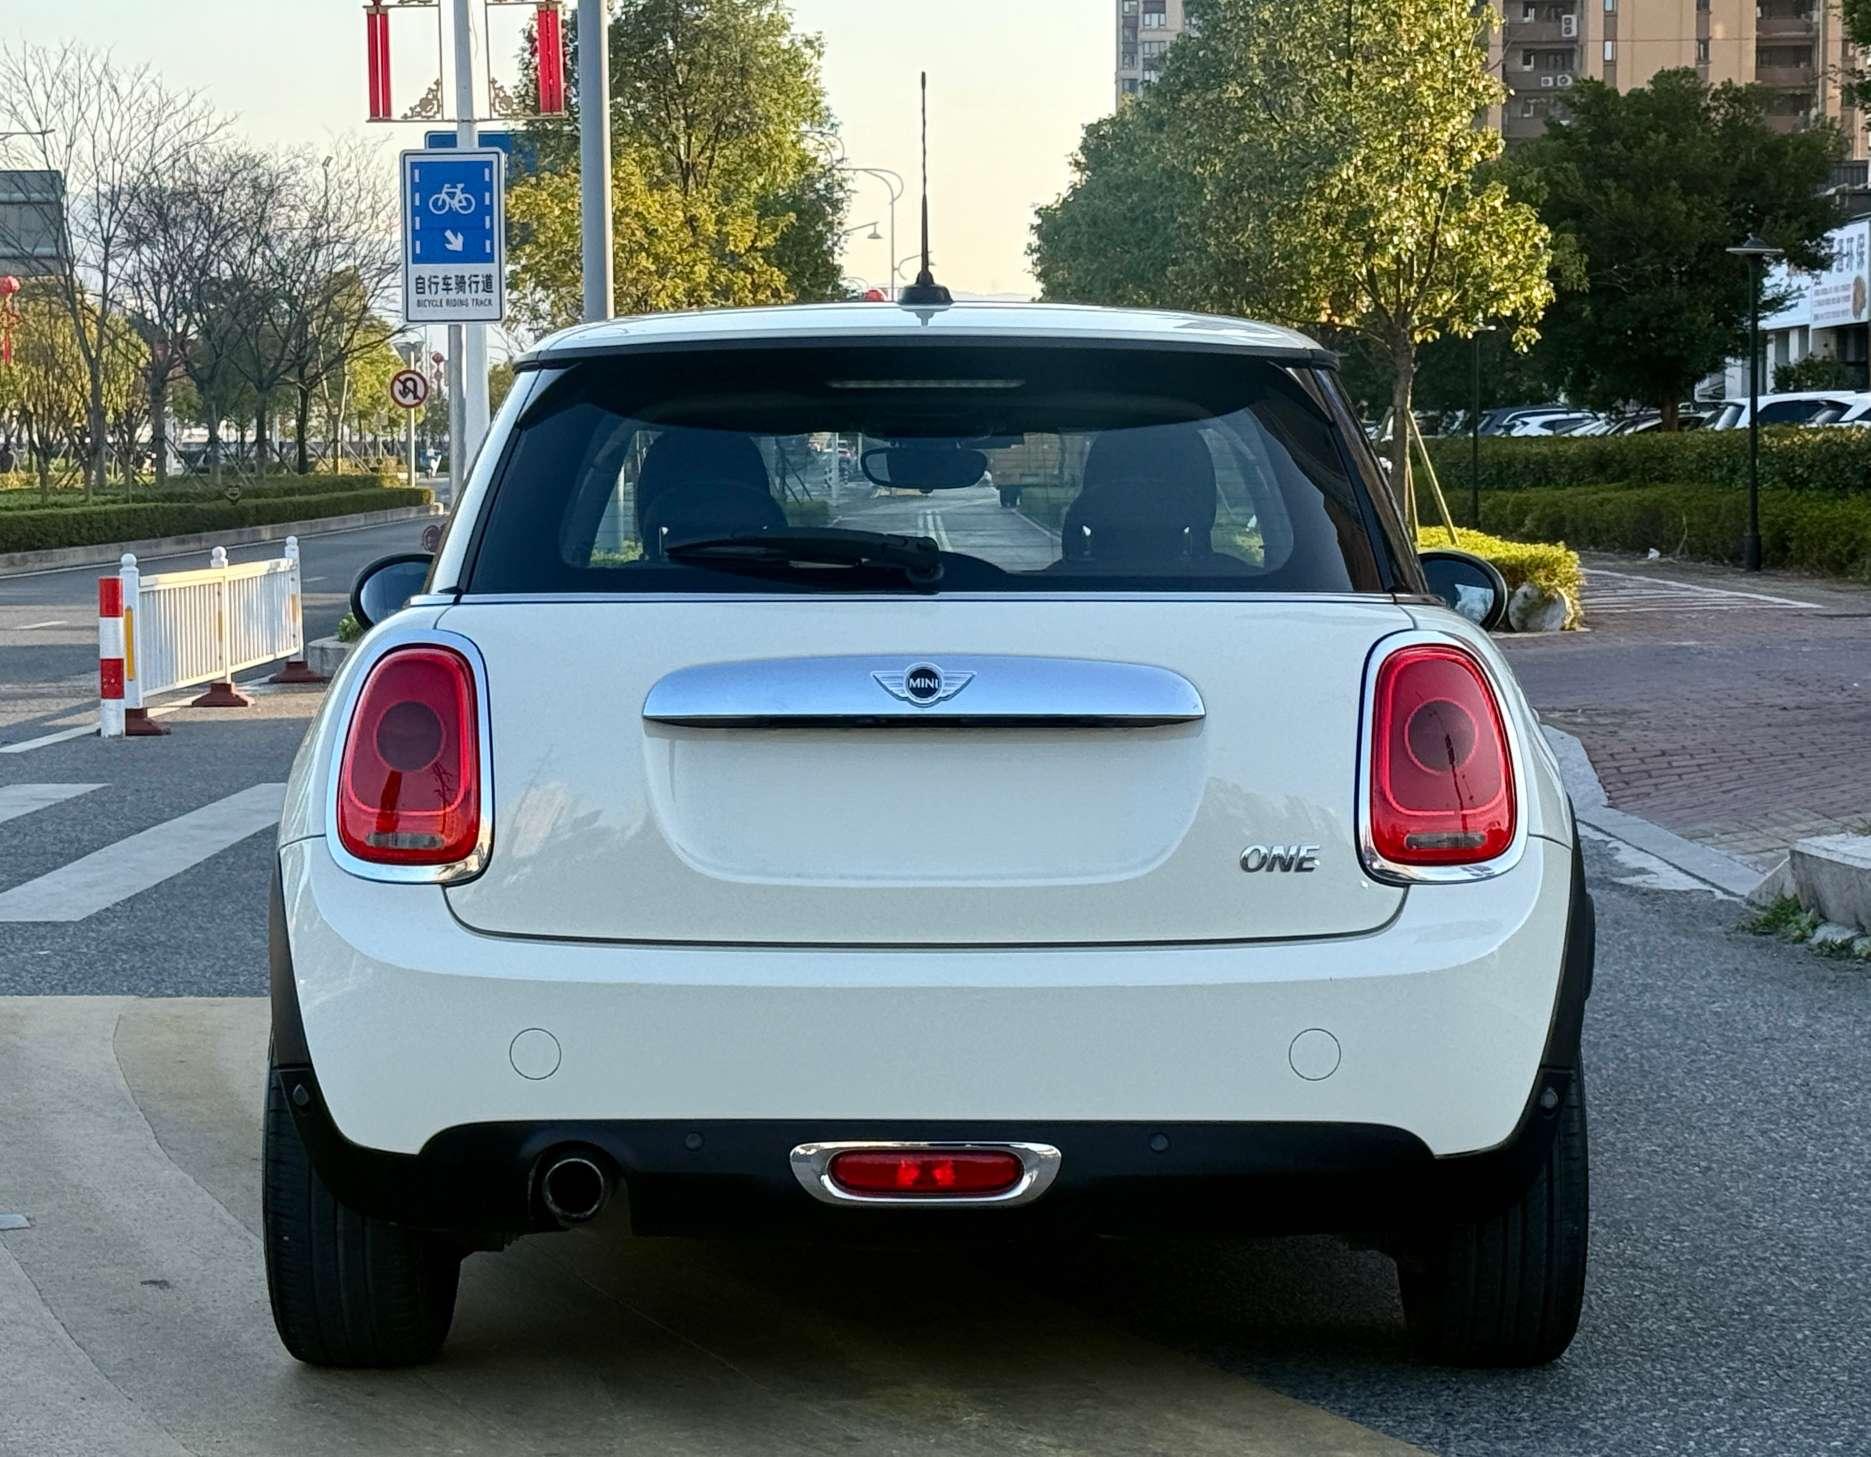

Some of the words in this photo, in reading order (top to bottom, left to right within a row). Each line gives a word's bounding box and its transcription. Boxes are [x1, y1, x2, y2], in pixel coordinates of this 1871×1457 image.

[415, 273, 494, 295] 自行车骑行道
[416, 298, 444, 308] BICYCLE
[446, 298, 469, 308] RIDING
[472, 297, 493, 307] TRACK
[908, 678, 939, 689] MINI
[1240, 844, 1320, 873] ONE
